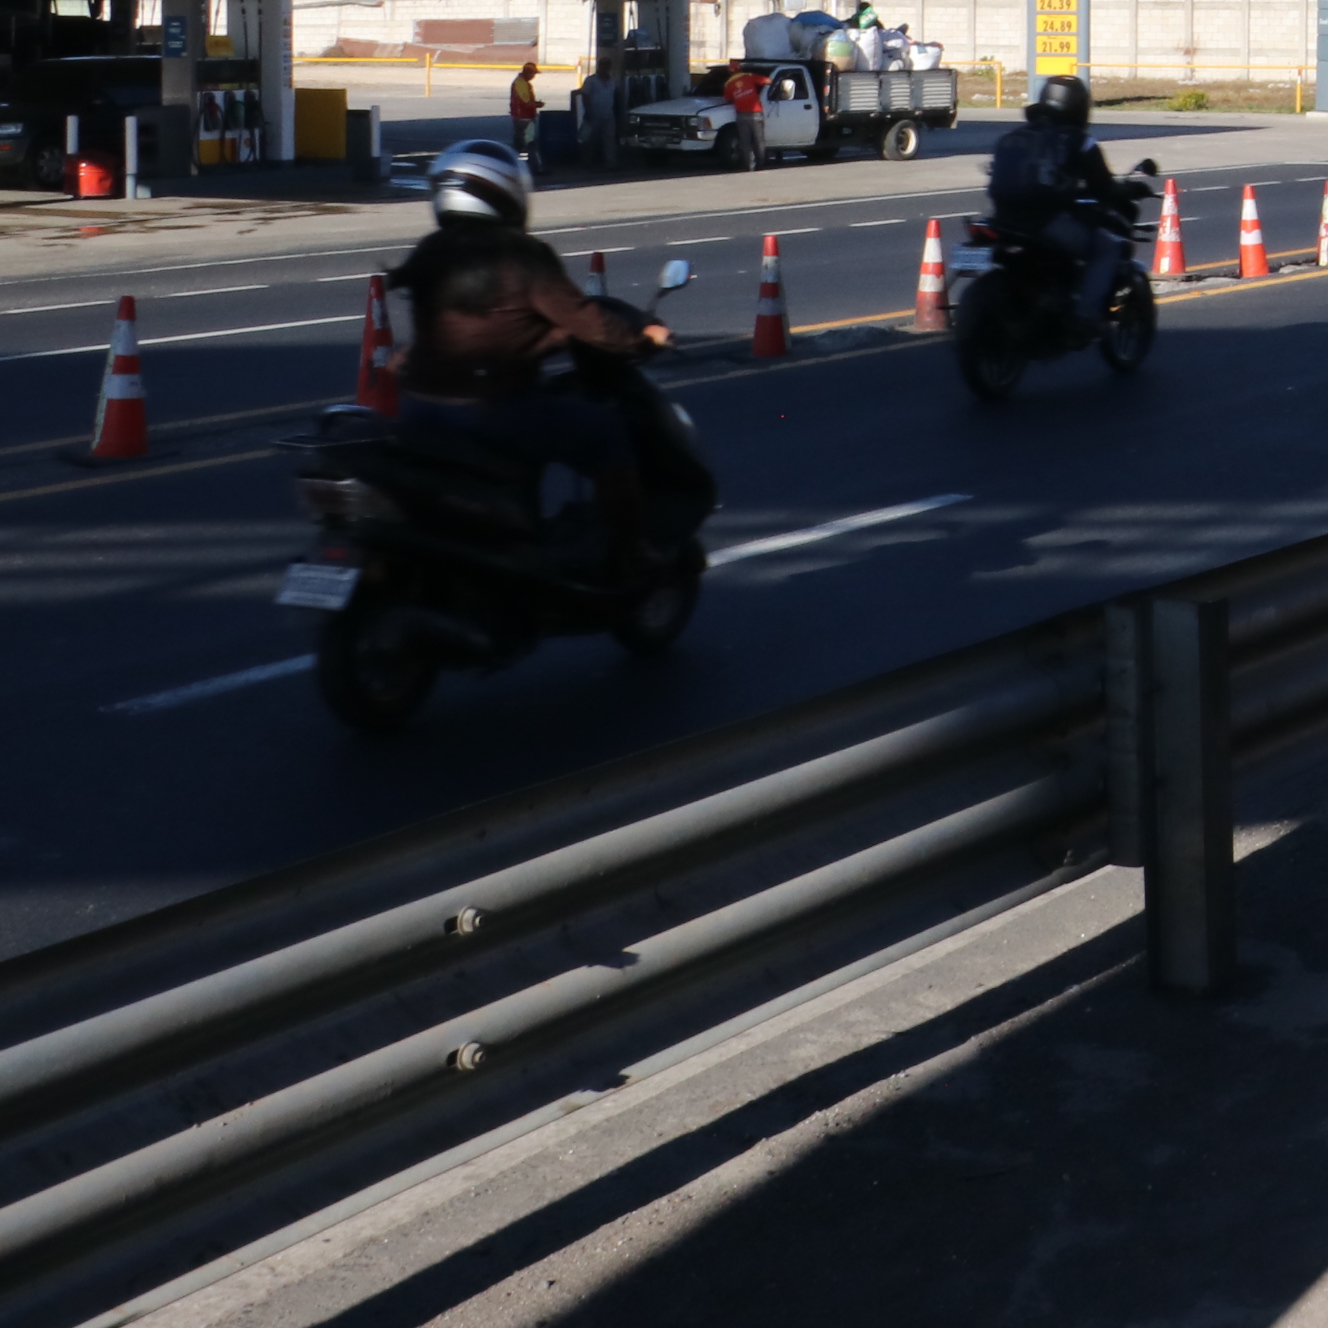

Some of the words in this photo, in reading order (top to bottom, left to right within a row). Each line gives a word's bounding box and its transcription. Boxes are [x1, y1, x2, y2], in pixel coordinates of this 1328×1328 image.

[1040, 0, 1072, 10] 24.39
[1043, 21, 1072, 32] 24.89
[1042, 42, 1071, 53] 21.99
